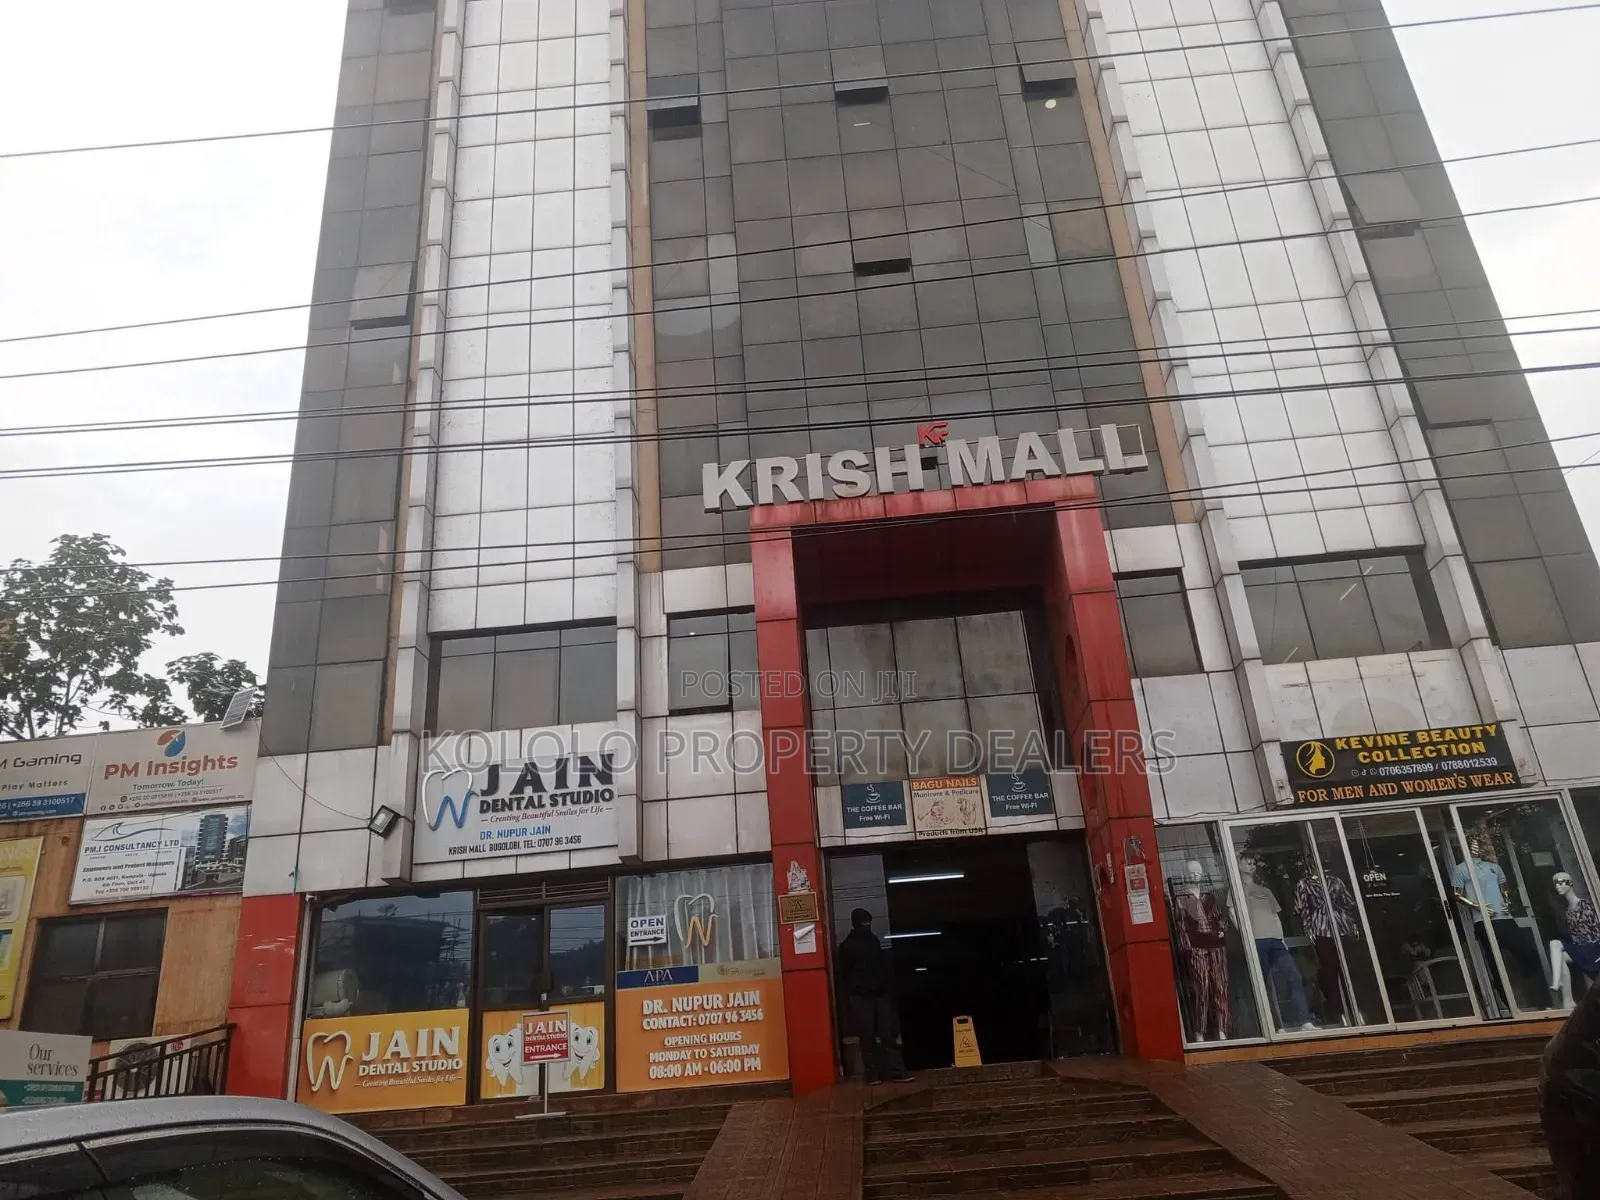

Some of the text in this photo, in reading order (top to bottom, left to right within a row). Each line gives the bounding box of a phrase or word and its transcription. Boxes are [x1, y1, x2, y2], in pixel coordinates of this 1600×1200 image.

[702, 424, 1148, 513] KRISH MALL
[1336, 724, 1497, 750] KEVINE BEAUTY
[14, 754, 82, 768] Gaming
[1358, 742, 1486, 764] COLLECTION
[104, 755, 238, 780] PM Insights
[1380, 763, 1434, 776] 0706357899
[1442, 757, 1498, 770] 0788012539
[480, 753, 614, 797] JAIN
[28, 780, 68, 788] Matters
[132, 778, 204, 791] Tomorrow, Today!
[912, 778, 977, 790] BAGU NAILS
[952, 788, 979, 796] Pedicure
[1298, 772, 1516, 803] FOR MEN AND WOMEN'S WEAR
[480, 788, 614, 814] DENTAL STUDIO
[490, 806, 604, 823] Creating Beautiful Smiles for Life
[480, 825, 551, 840] DR. NUPUR JAIN
[918, 829, 948, 837] Products
[104, 841, 162, 852] CONSULTANCY
[449, 835, 582, 856] KRISH MALL BUGOLOBI, TEL: 0707 96 3456
[1364, 873, 1386, 882] OPEN
[630, 917, 664, 928] OPEN
[630, 928, 664, 938] ENTRANCE
[643, 990, 760, 1015] DR. NUPUR JAIN
[525, 1020, 566, 1034] JAIN
[643, 1008, 764, 1030] CONTACT: 0707 96 3456
[362, 1026, 460, 1062] JAIN
[664, 1031, 742, 1046] OPENING HOURS
[30, 1044, 54, 1060] Our
[525, 1043, 568, 1054] ENTRANCE
[650, 1044, 760, 1062] MONDAY TO SATURDAY
[27, 1061, 78, 1076] services
[358, 1058, 464, 1076] DENTAL STUDIO
[650, 1064, 682, 1079] 08:00
[685, 1062, 702, 1076] AM
[710, 1060, 740, 1074] 06:00
[744, 1057, 761, 1072] PM
